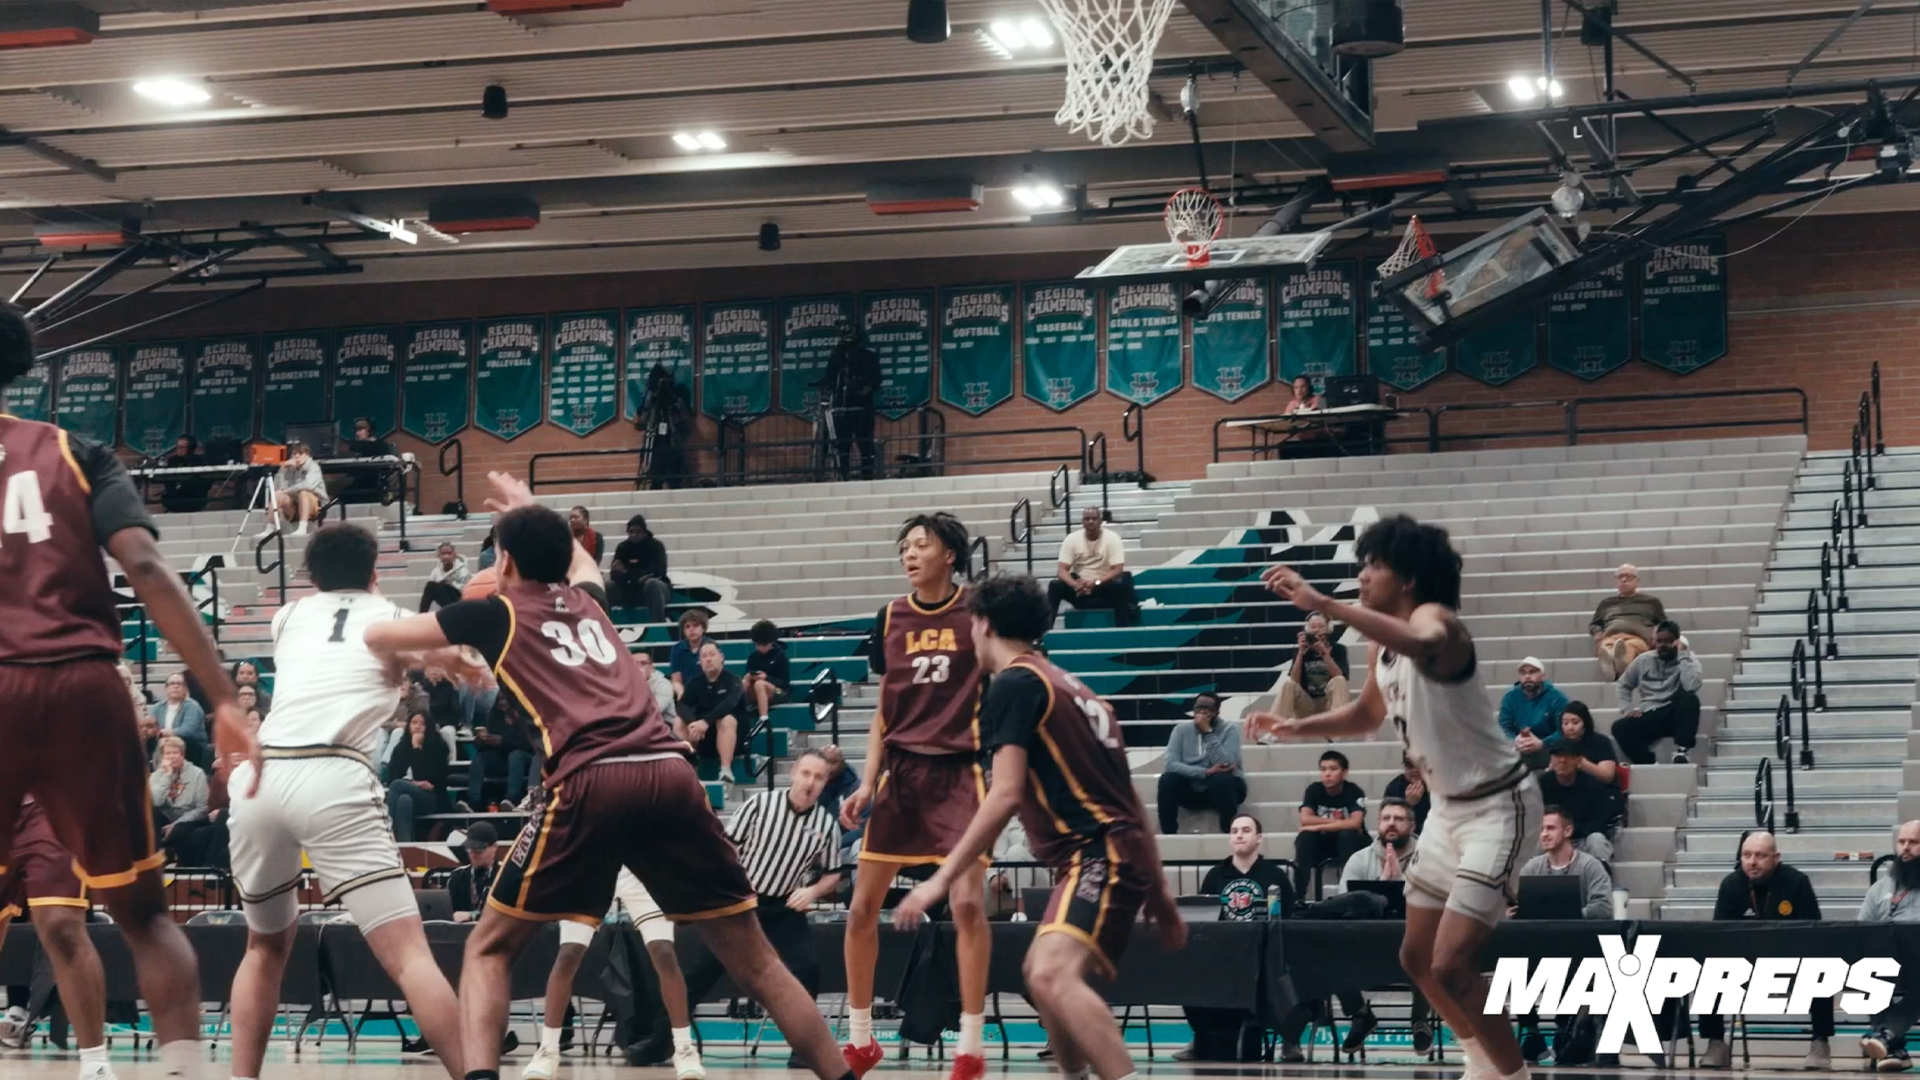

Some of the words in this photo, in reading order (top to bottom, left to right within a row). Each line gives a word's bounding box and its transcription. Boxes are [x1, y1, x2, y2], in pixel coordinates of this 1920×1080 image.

[1653, 244, 1709, 260] REGION
[1645, 256, 1719, 280] CHAMPIONS
[1667, 274, 1696, 284] GIRLS
[1035, 288, 1085, 302] REGION
[1282, 283, 1350, 305] CHAMPIONS
[1552, 292, 1575, 302] FLAG
[1578, 289, 1623, 299] FOOTBALL
[1643, 287, 1670, 296] BEACH
[1672, 284, 1720, 294] VOLLEYBALL
[872, 298, 920, 312] REGION
[952, 293, 1002, 307] REGION
[1111, 293, 1177, 315] CHAMPIONS
[1302, 299, 1329, 308] GIRLS
[714, 309, 761, 323] REGION
[791, 303, 839, 317] REGION
[945, 305, 1009, 326] CHAMPIONS
[1028, 299, 1093, 321] CHAMPIONS
[1226, 311, 1262, 321] TENNIS
[1284, 310, 1311, 319] TRACK
[1323, 307, 1349, 317] FIELD
[561, 319, 607, 332] REGION
[637, 315, 684, 328] REGION
[865, 309, 927, 331] CHAMPIONS
[1110, 318, 1140, 328] GIRLS
[1142, 315, 1178, 326] TENNIS
[487, 324, 533, 338] REGION
[707, 319, 767, 341] CHAMPIONS
[953, 327, 1000, 338] SOFTBALL
[1036, 322, 1084, 333] BASEBALL
[344, 333, 388, 347] REGION
[415, 328, 460, 342] REGION
[555, 329, 614, 350] CHAMPIONS
[630, 325, 690, 346] CHAMPIONS
[869, 332, 923, 343] WRESTLING
[204, 343, 247, 355] REGION
[274, 338, 317, 351] REGION
[408, 339, 466, 360] CHAMPIONS
[480, 335, 539, 355] CHAMPIONS
[571, 346, 596, 355] GIRLS
[705, 345, 731, 354] GIRLS
[734, 342, 767, 353] SOCCER
[785, 339, 808, 349] BOYS
[69, 352, 110, 365] REGION
[136, 347, 178, 359] REGION
[268, 348, 323, 369] CHAMPIONS
[337, 344, 394, 365] CHAMPIONS
[497, 350, 521, 359] GIRLS
[560, 354, 608, 364] BASKETBALL
[129, 357, 184, 377] CHAMPIONS
[197, 354, 253, 373] CHAMPIONS
[486, 358, 532, 368] VOLLEYBALL
[62, 362, 116, 381] CHAMPIONS
[270, 370, 320, 381] BADMINTON
[0, 470, 54, 548] 4
[327, 608, 349, 642] 1
[541, 618, 617, 666] 30
[905, 628, 957, 655] LCA
[911, 655, 950, 684] 23
